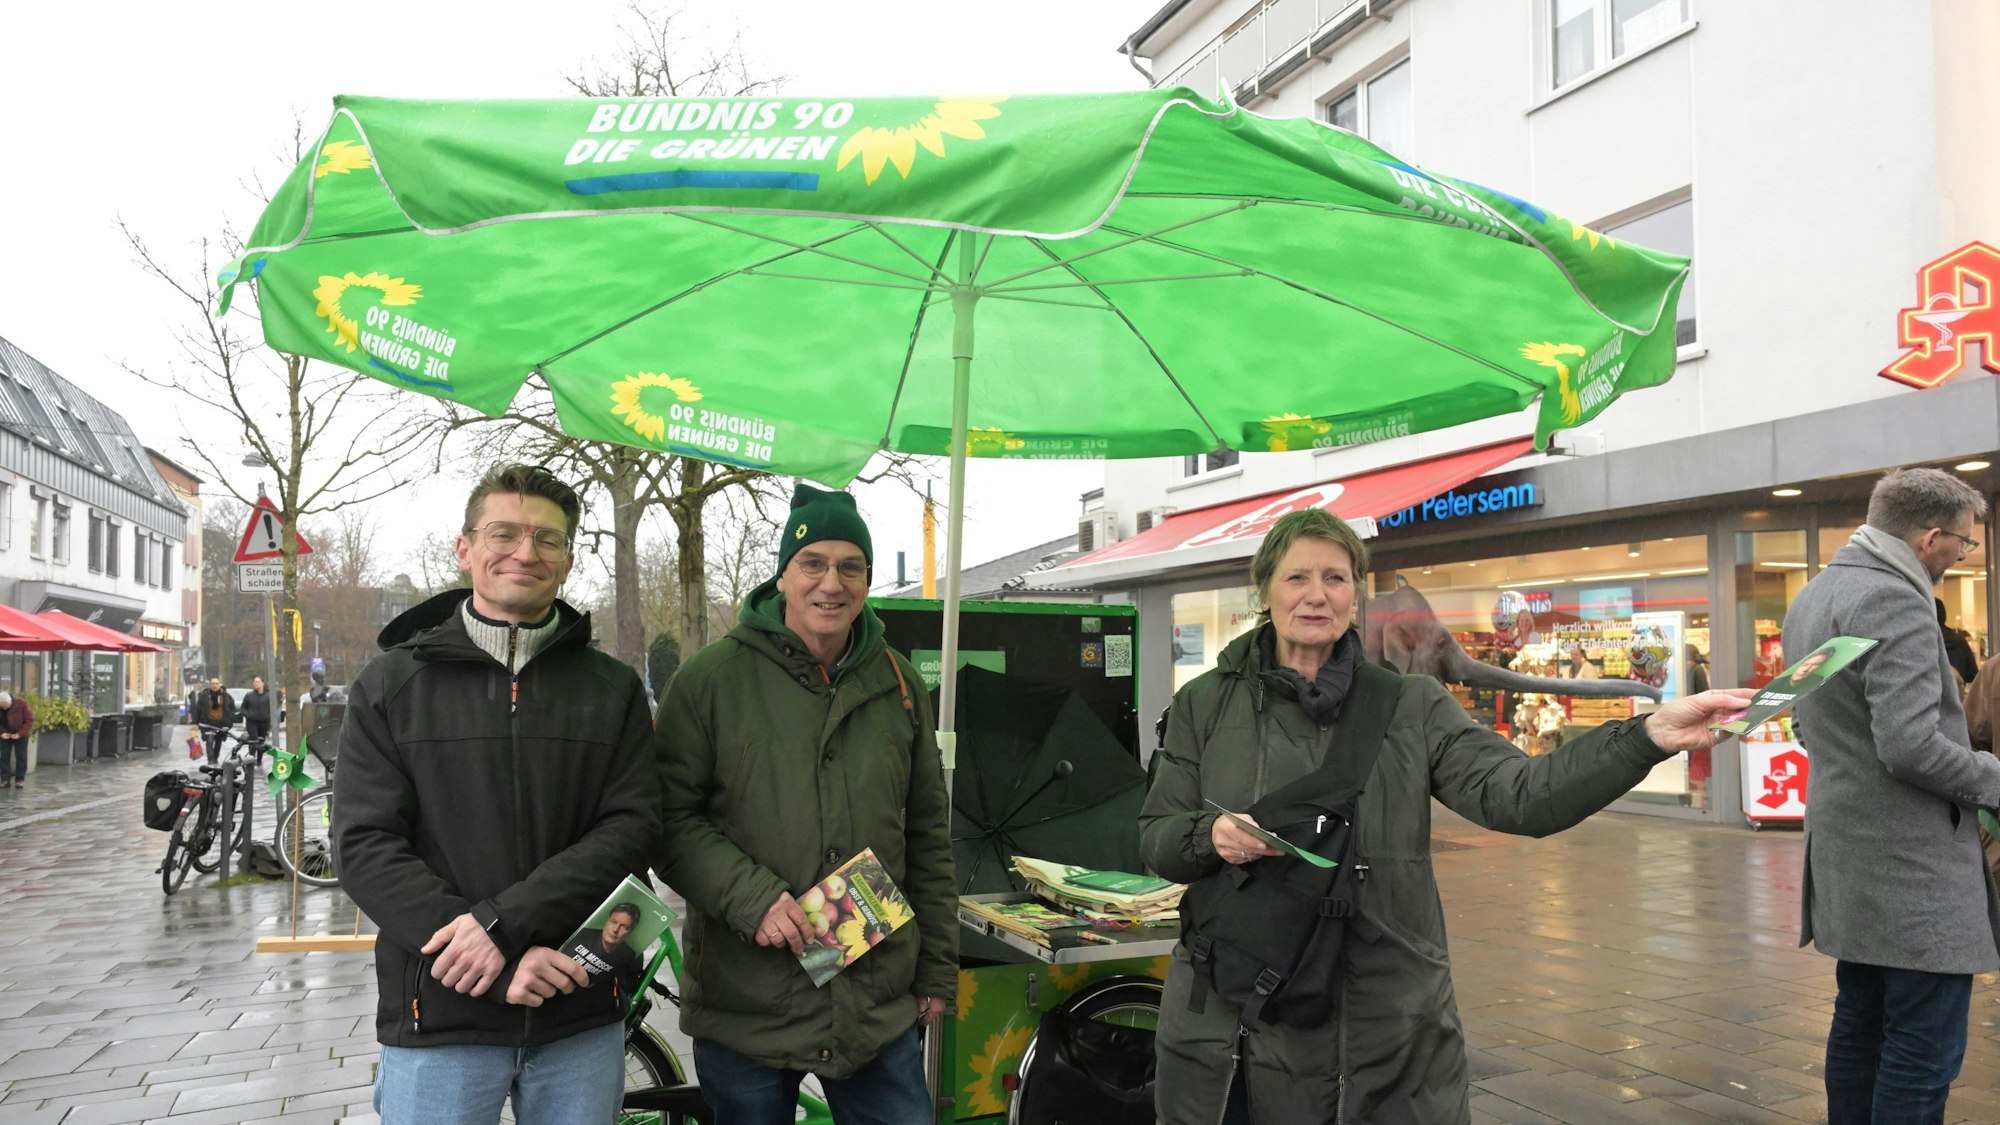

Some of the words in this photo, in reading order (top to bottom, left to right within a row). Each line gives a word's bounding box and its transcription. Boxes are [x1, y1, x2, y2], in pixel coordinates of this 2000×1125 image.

[586, 98, 782, 134] BÜNDNIS
[791, 101, 855, 131] 90
[564, 138, 641, 166] DIE
[650, 132, 838, 162] GRÜNEN
[1422, 482, 1535, 521] Petersenn
[247, 579, 285, 588] schäde
[1552, 621, 1591, 633] Herzlich
[1593, 619, 1633, 632] willkom
[849, 887, 862, 902] OBST
[574, 944, 590, 957] EIN
